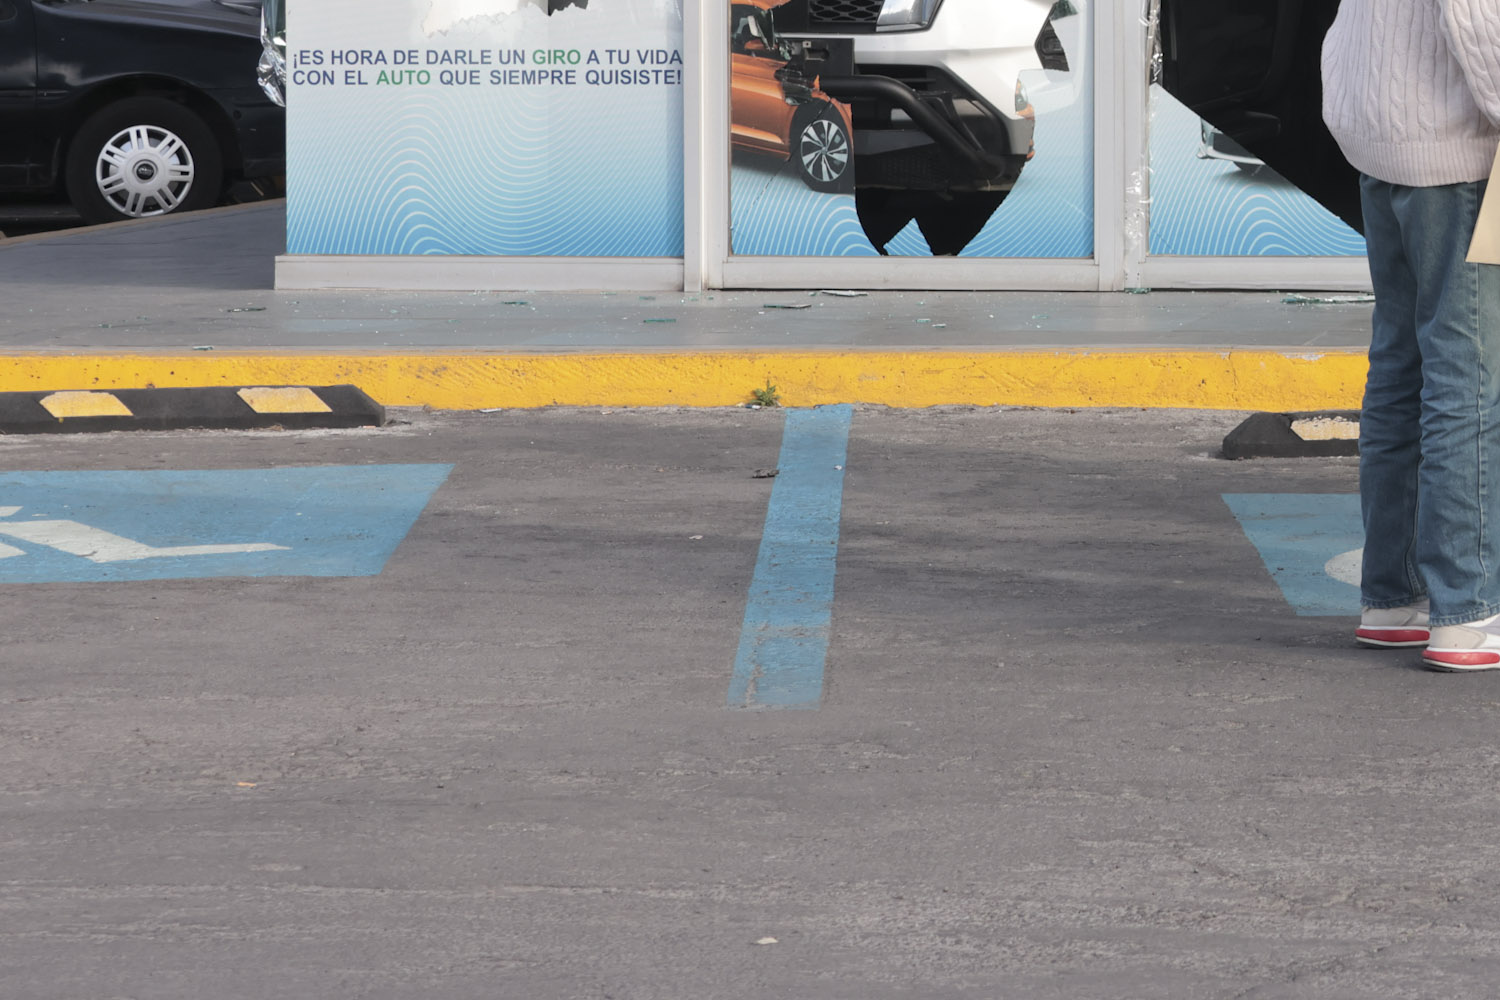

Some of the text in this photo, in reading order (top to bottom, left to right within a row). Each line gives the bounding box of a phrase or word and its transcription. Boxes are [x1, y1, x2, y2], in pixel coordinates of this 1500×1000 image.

[292, 49, 683, 68] ¡ES HORA DE DARLE UN GIRO A TU VIDA
[292, 69, 682, 86] CON EL AUTO QUE SIEMPRE QUISISTE!
